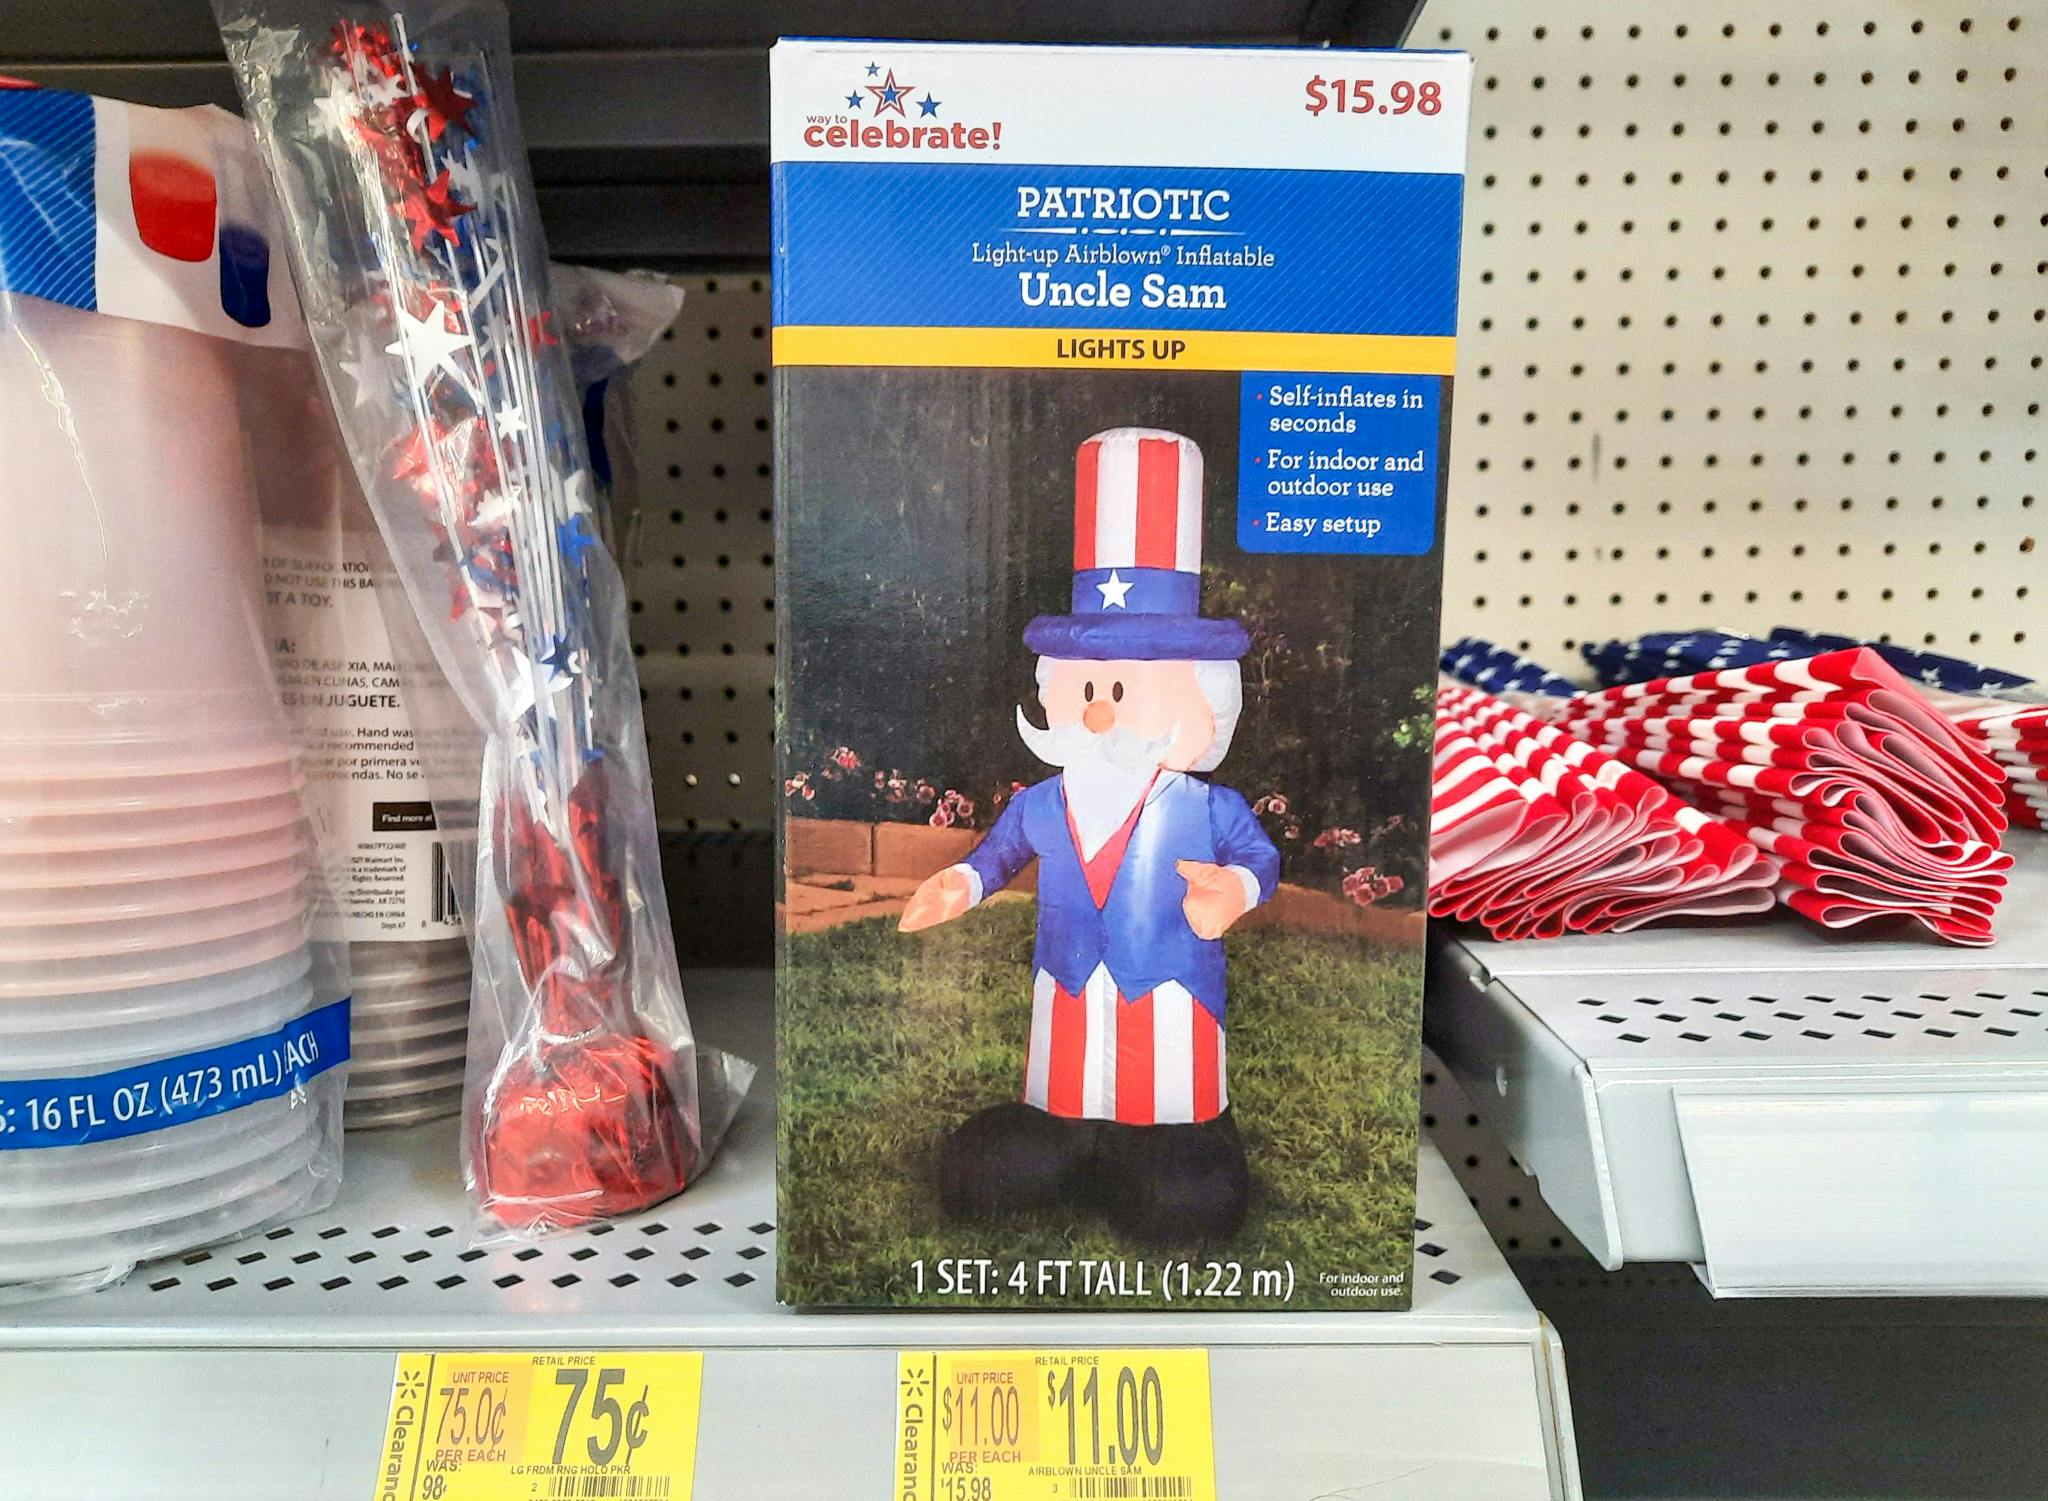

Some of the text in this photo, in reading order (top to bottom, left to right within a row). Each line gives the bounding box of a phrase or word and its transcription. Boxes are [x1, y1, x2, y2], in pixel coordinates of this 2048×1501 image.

[1305, 75, 1442, 116] $15.98
[806, 114, 848, 125] way to
[803, 119, 1002, 150] celebrate!
[1016, 186, 1231, 222] PATRIOTIC
[972, 241, 1059, 268] Light-up
[1176, 244, 1276, 268] Inflatable
[1018, 270, 1227, 310] Uncle Sam
[1056, 338, 1186, 361] LIGHTS UP
[1269, 384, 1424, 409] Self-inflates in
[1269, 411, 1357, 433] seconds
[1267, 448, 1424, 472] For indoor and
[1267, 474, 1394, 497] outdoor use
[1265, 512, 1381, 538] Easy setup
[357, 728, 389, 737] Hand
[361, 757, 407, 768] primera
[387, 770, 403, 780] No
[382, 814, 401, 823] Find
[402, 815, 423, 823] more
[25, 1097, 61, 1131] 16
[69, 1095, 106, 1129] FL
[113, 1081, 154, 1123] OZ
[161, 1067, 224, 1115] (473
[232, 1050, 282, 1093] mL)
[910, 1258, 1295, 1302] 1 SET: 4 FT TALL (1.22 m)
[1320, 1271, 1405, 1283] For indoor and
[1330, 1286, 1378, 1296] outdoor
[532, 1356, 596, 1366] RETAIL PRICE
[1035, 1356, 1099, 1366] RETAIL PRICE
[453, 1371, 509, 1384] UNIT PRICE
[956, 1372, 1014, 1385] UNIT PRICE
[436, 1387, 508, 1452] 75.0¢
[552, 1369, 650, 1465] 75¢
[942, 1386, 1019, 1446] $11.00
[1047, 1366, 1164, 1466] $11.00
[435, 1449, 506, 1462] PER EACH
[950, 1451, 1021, 1463] PER EACH
[426, 1459, 462, 1472] WAS:
[511, 1466, 631, 1475] LG FRDM RNG HOLO PKR
[941, 1461, 978, 1474] WAS:
[1028, 1466, 1142, 1476] AIRBLOWN UNCLE SAM
[531, 1482, 538, 1493] 2
[1052, 1483, 1058, 1493] 3
